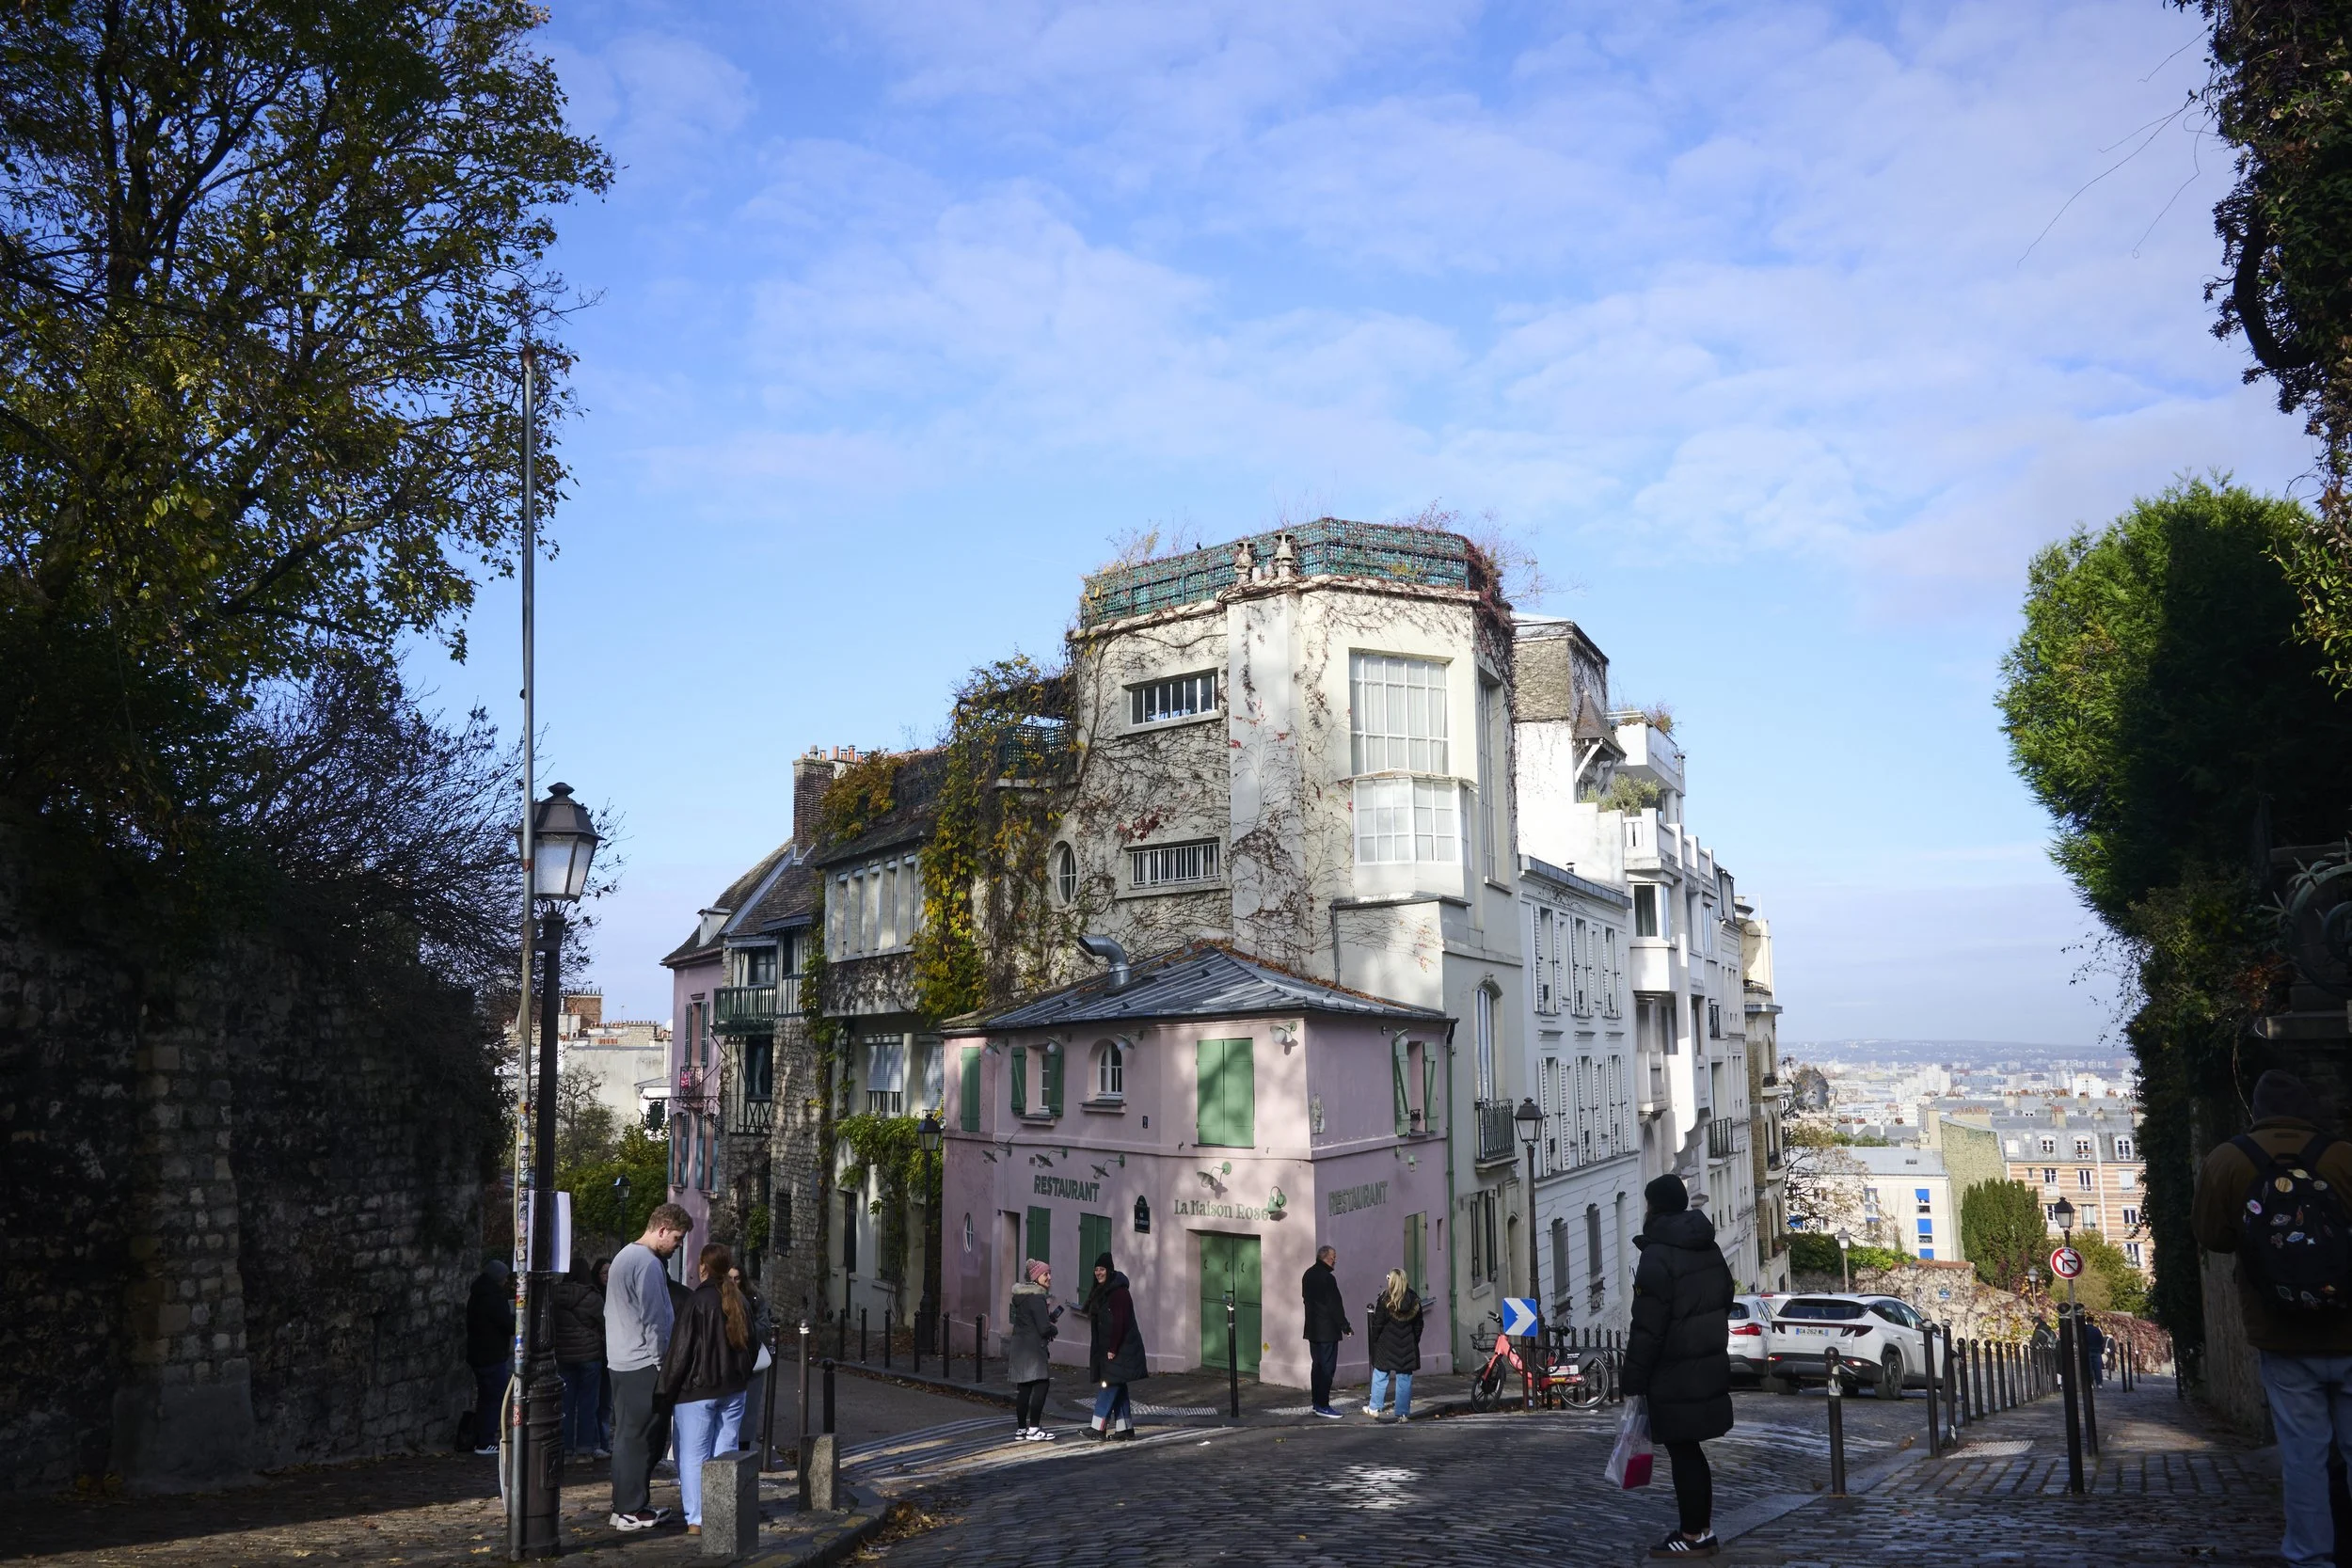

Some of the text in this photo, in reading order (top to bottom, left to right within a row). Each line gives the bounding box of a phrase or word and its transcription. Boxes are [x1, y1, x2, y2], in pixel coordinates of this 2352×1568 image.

[1034, 1175, 1100, 1202] RESTAURANT
[1328, 1180, 1389, 1216] RESTAURANT
[1174, 1199, 1269, 1221] La Maison Rose
